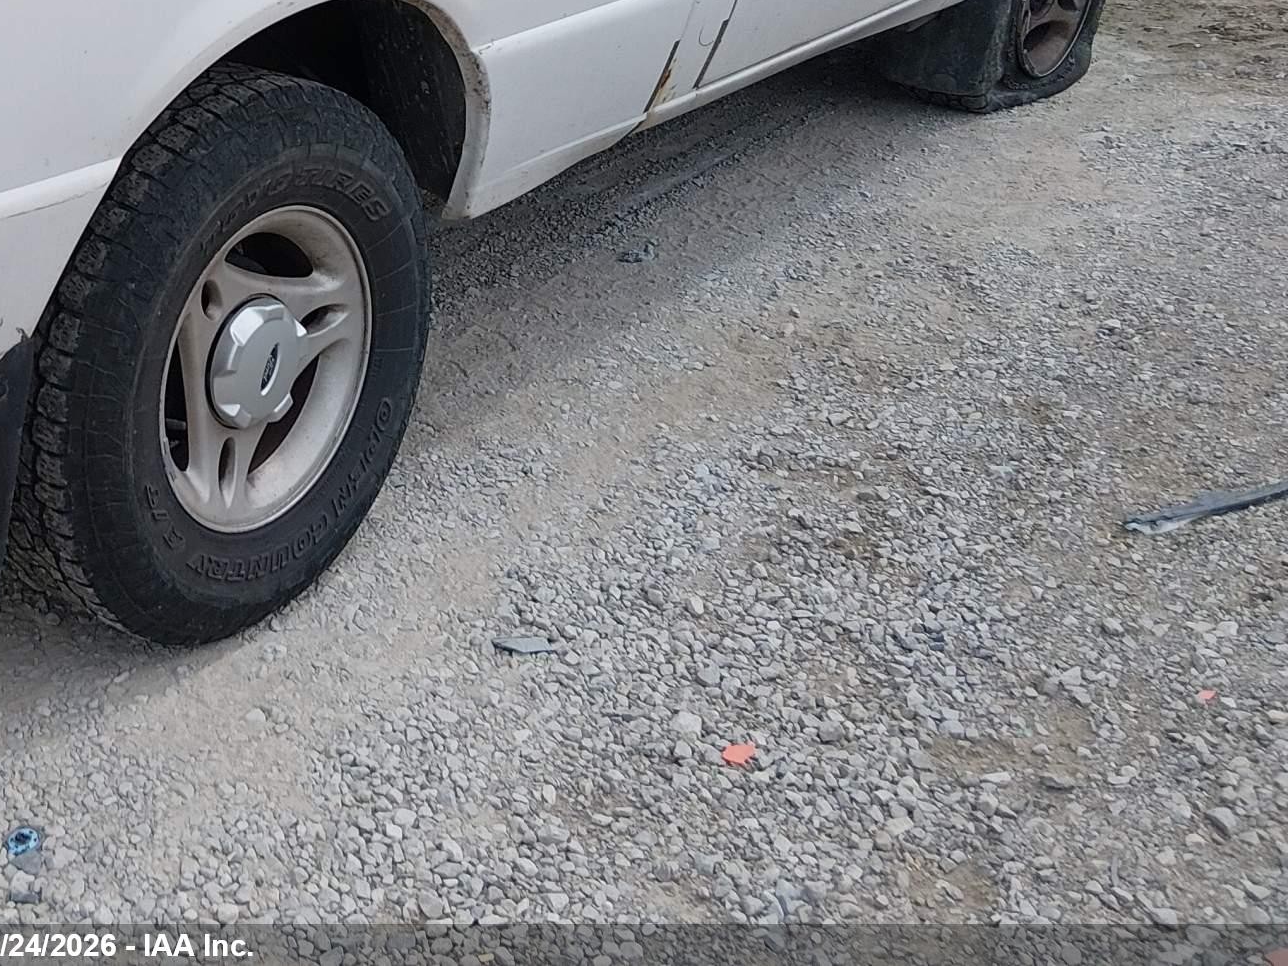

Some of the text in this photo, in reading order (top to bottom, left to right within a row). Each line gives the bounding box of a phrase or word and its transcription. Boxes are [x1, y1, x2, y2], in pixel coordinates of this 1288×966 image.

[295, 168, 392, 222] TIRES
[333, 397, 393, 519] OPEN
[186, 512, 329, 582] COUNTRY
